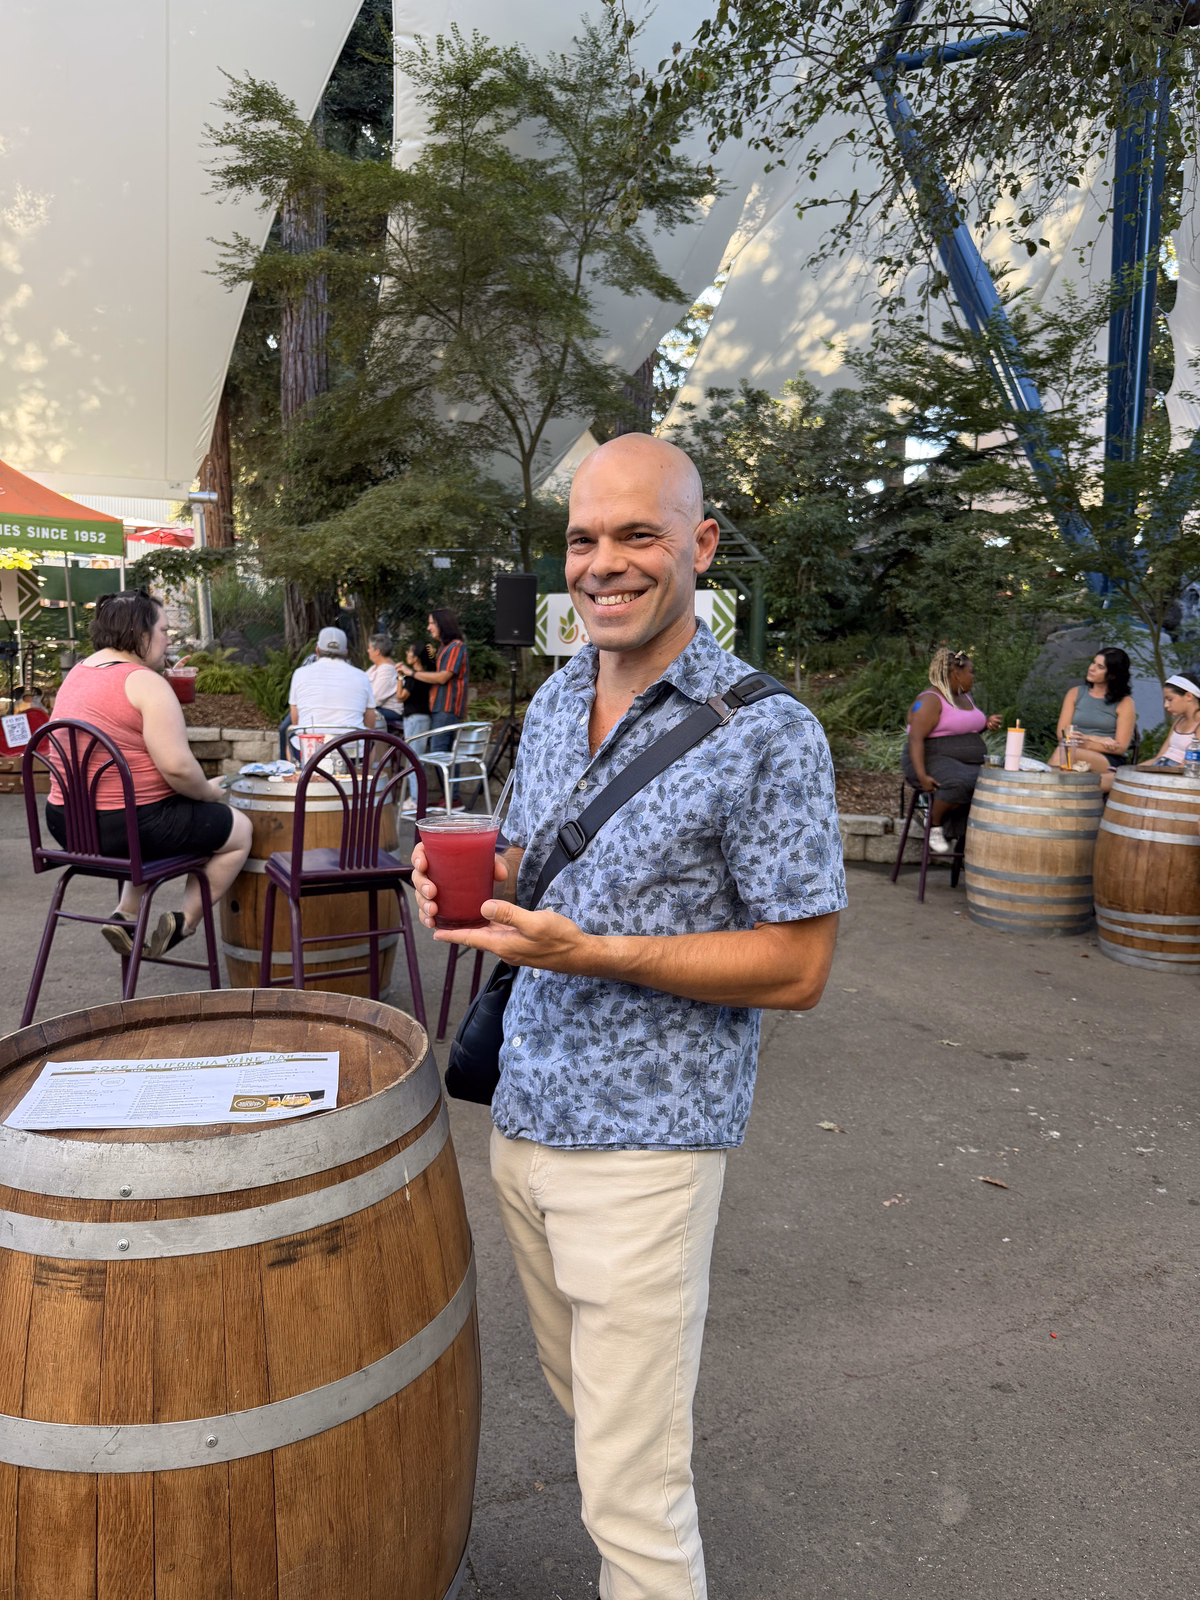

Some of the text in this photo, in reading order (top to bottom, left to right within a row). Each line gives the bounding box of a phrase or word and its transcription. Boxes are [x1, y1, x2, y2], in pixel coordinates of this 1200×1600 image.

[27, 526, 68, 540] SINCE
[74, 530, 106, 544] 1952
[136, 1060, 218, 1069] CALIFORNIA
[226, 1056, 261, 1064] WINE
